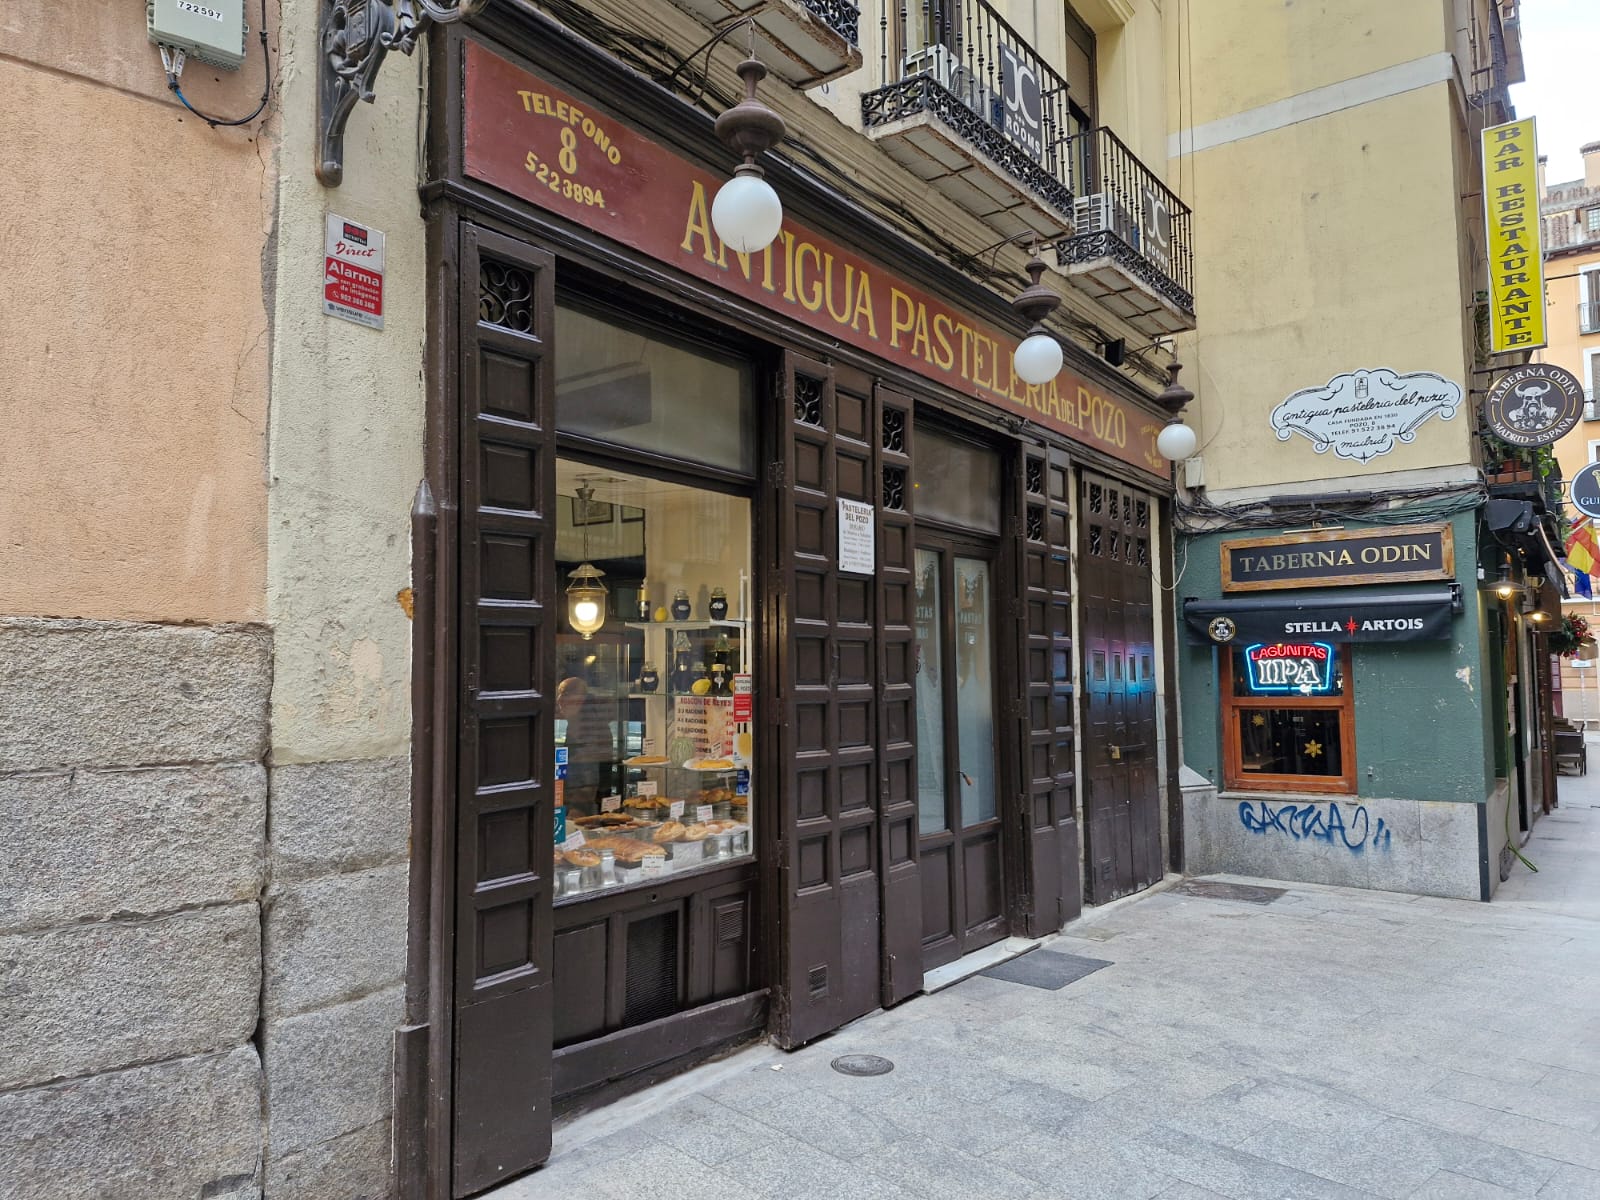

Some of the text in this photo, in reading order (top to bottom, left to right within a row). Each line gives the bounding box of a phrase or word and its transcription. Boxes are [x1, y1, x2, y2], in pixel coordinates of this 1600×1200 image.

[178, 1, 222, 19] 722597
[517, 90, 621, 165] TELEFONO
[1006, 113, 1041, 155] ROOMS
[558, 126, 577, 175] 8
[335, 240, 377, 257] Direct
[1494, 126, 1533, 347] BAR RESTAURANTE
[328, 260, 380, 288] Alarma
[1490, 368, 1578, 404] TABERNA ODIN
[1060, 397, 1078, 427] DEL
[1077, 385, 1127, 449] POZO
[1240, 543, 1432, 574] TABERNA ODIN
[1285, 618, 1424, 634] STELLA ARTOIS
[1250, 645, 1327, 661] LAGUNITAS
[1257, 658, 1320, 684] IPA
